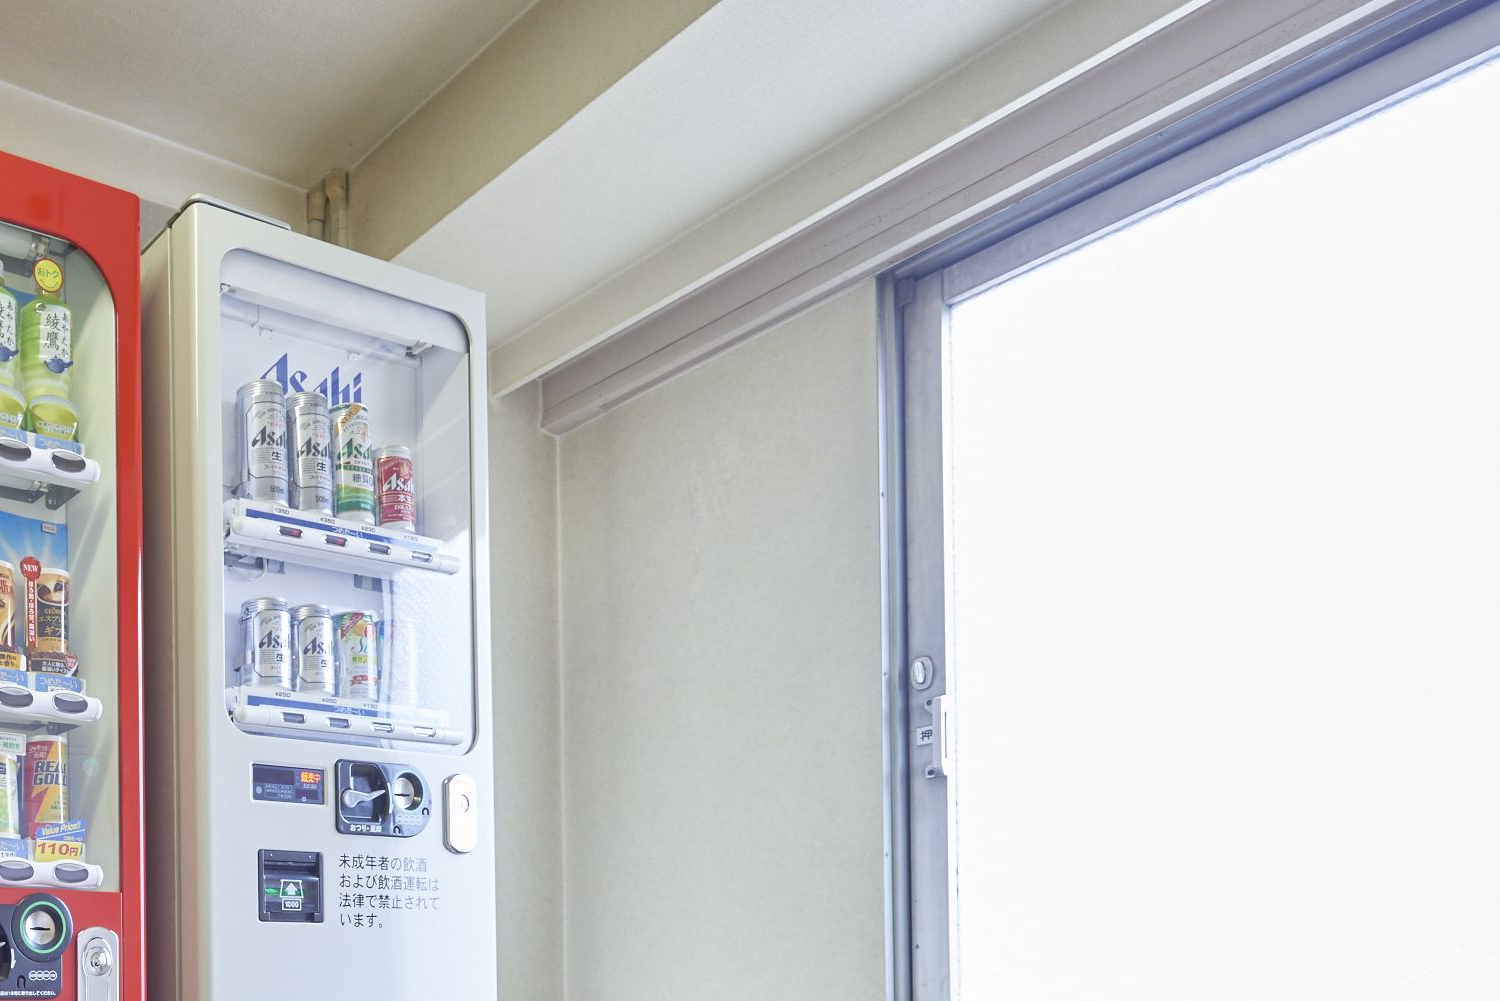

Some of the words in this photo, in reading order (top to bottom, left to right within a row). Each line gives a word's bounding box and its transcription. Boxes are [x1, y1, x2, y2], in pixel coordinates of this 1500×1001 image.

[36, 267, 60, 279] おトク
[44, 313, 61, 351] 綾鷹
[271, 451, 282, 461] 生
[316, 461, 327, 472] 生
[23, 564, 38, 573] NEW
[42, 826, 60, 836] Value
[60, 821, 81, 831] Price!!
[37, 842, 79, 856] 110円
[338, 853, 427, 872] 未成年者の飲酒
[339, 874, 440, 893] および飲酒運転は
[283, 901, 299, 909] 1000
[339, 893, 441, 911] 法律で禁止されて
[340, 913, 384, 929] います。
